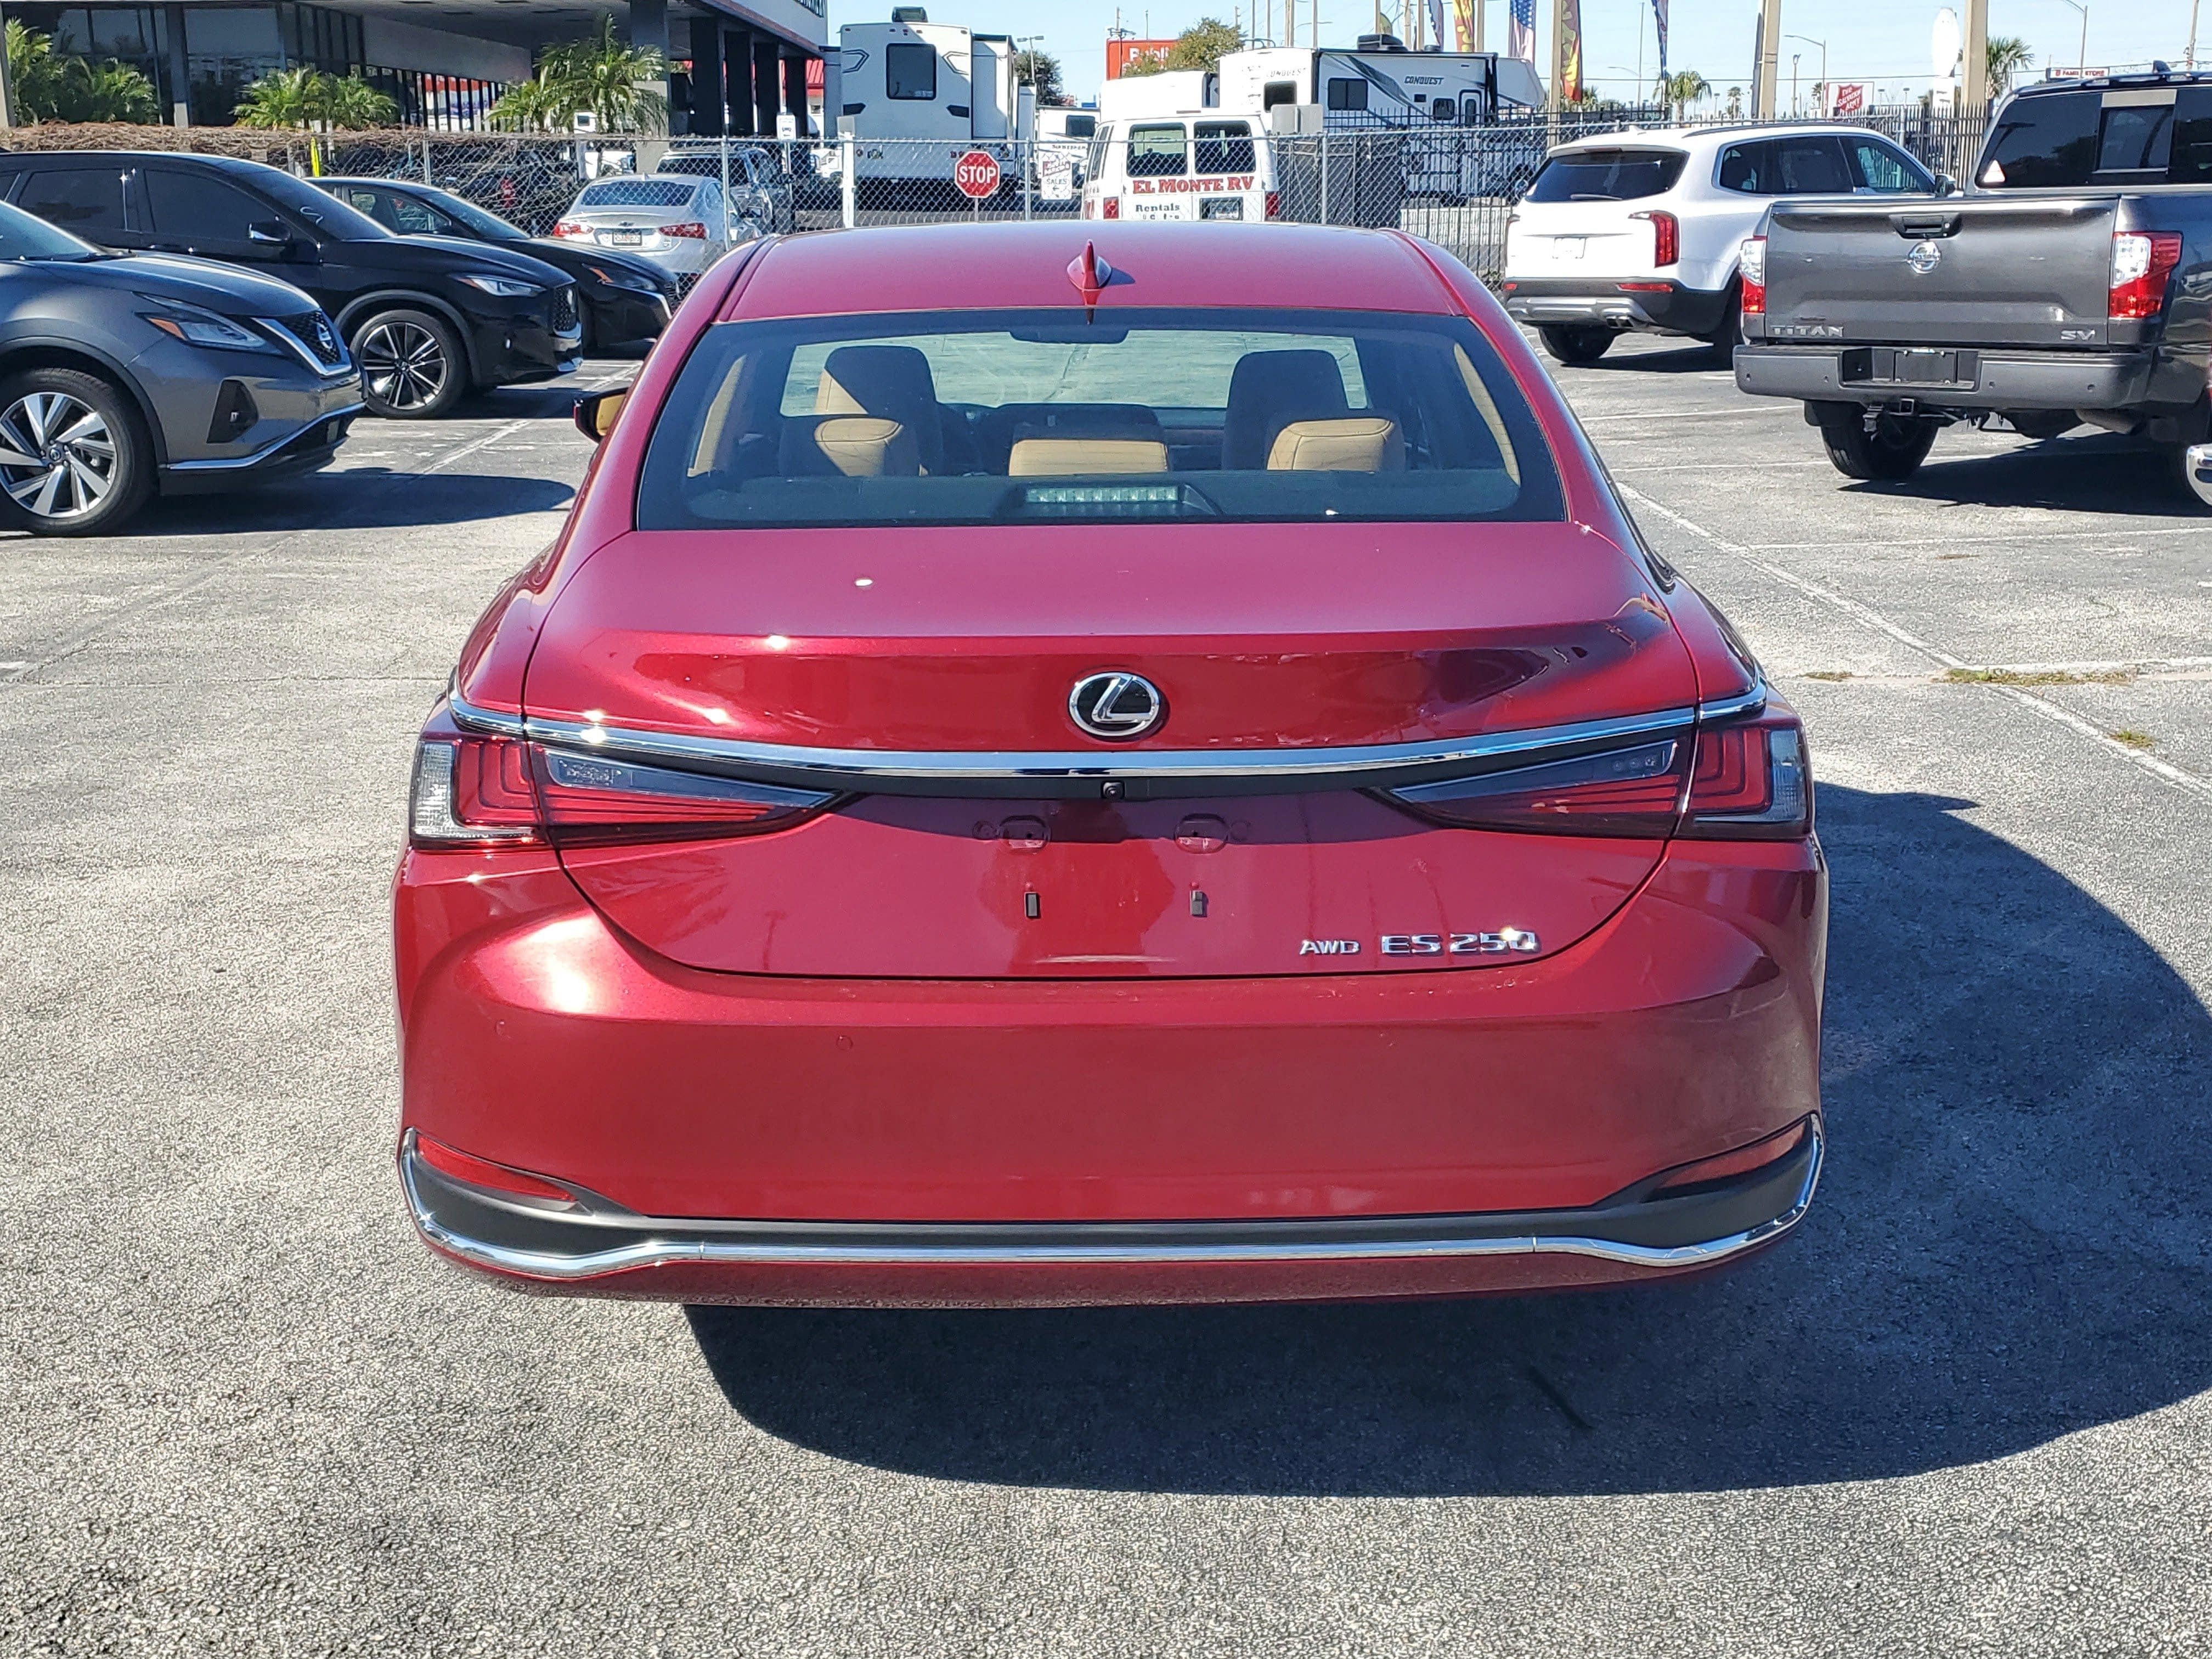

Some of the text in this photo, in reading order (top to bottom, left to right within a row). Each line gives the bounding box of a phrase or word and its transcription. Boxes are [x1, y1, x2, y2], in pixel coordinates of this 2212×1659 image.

[1404, 76, 1444, 85] CONQUEST
[958, 166, 996, 183] STOP
[1133, 176, 1255, 194] EL MONTE RV
[1136, 204, 1180, 212] Rentals
[1770, 325, 2095, 341] TITAN SV
[1300, 931, 1536, 955] AWD ES 250
